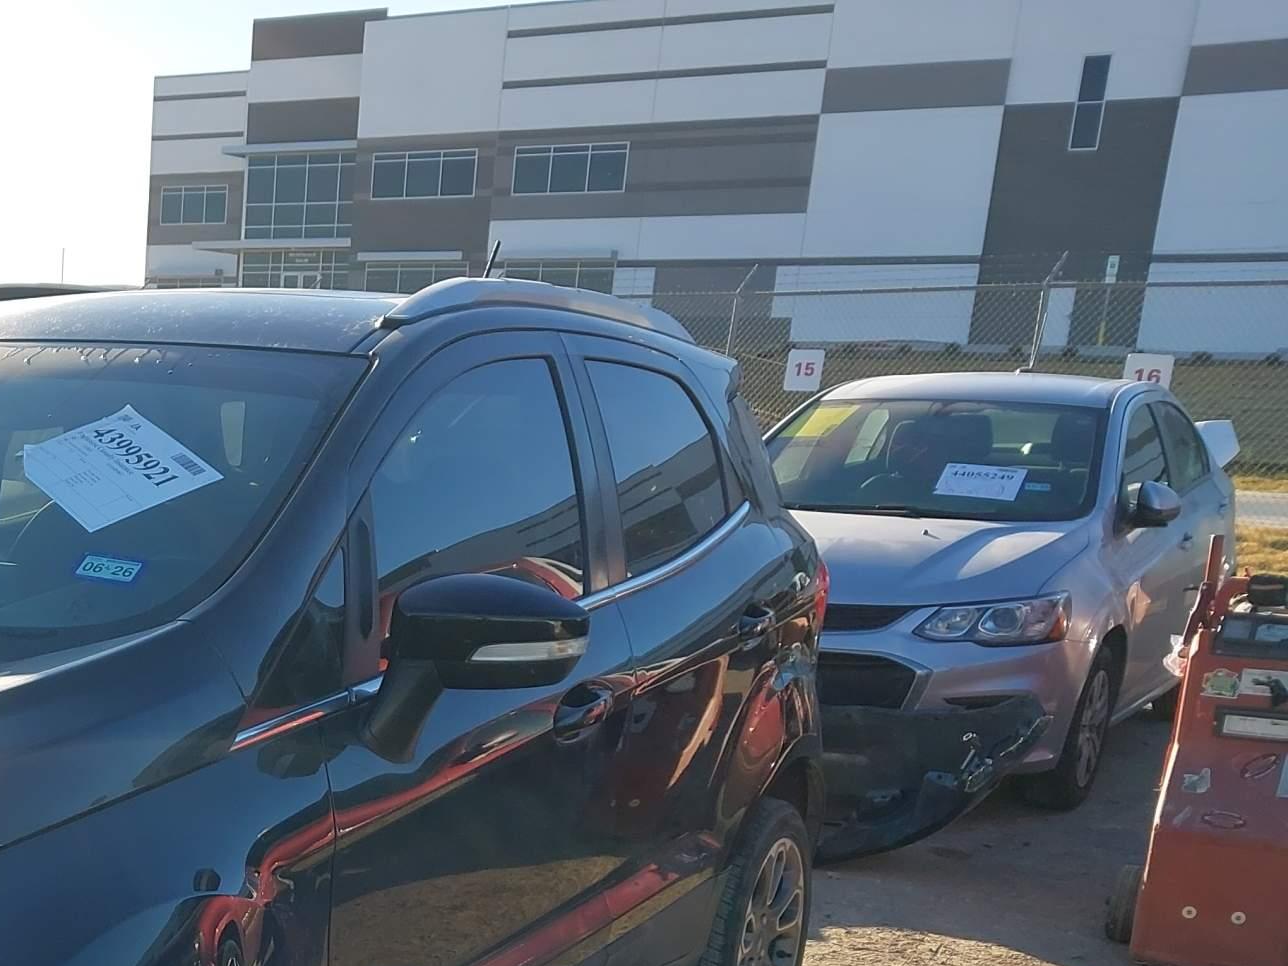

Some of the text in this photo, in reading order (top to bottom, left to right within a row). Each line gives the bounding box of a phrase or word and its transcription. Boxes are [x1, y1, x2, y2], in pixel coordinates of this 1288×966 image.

[794, 362, 815, 377] 15
[1135, 367, 1161, 383] 16
[93, 428, 179, 487] 43995921
[82, 561, 134, 577] 06 26
